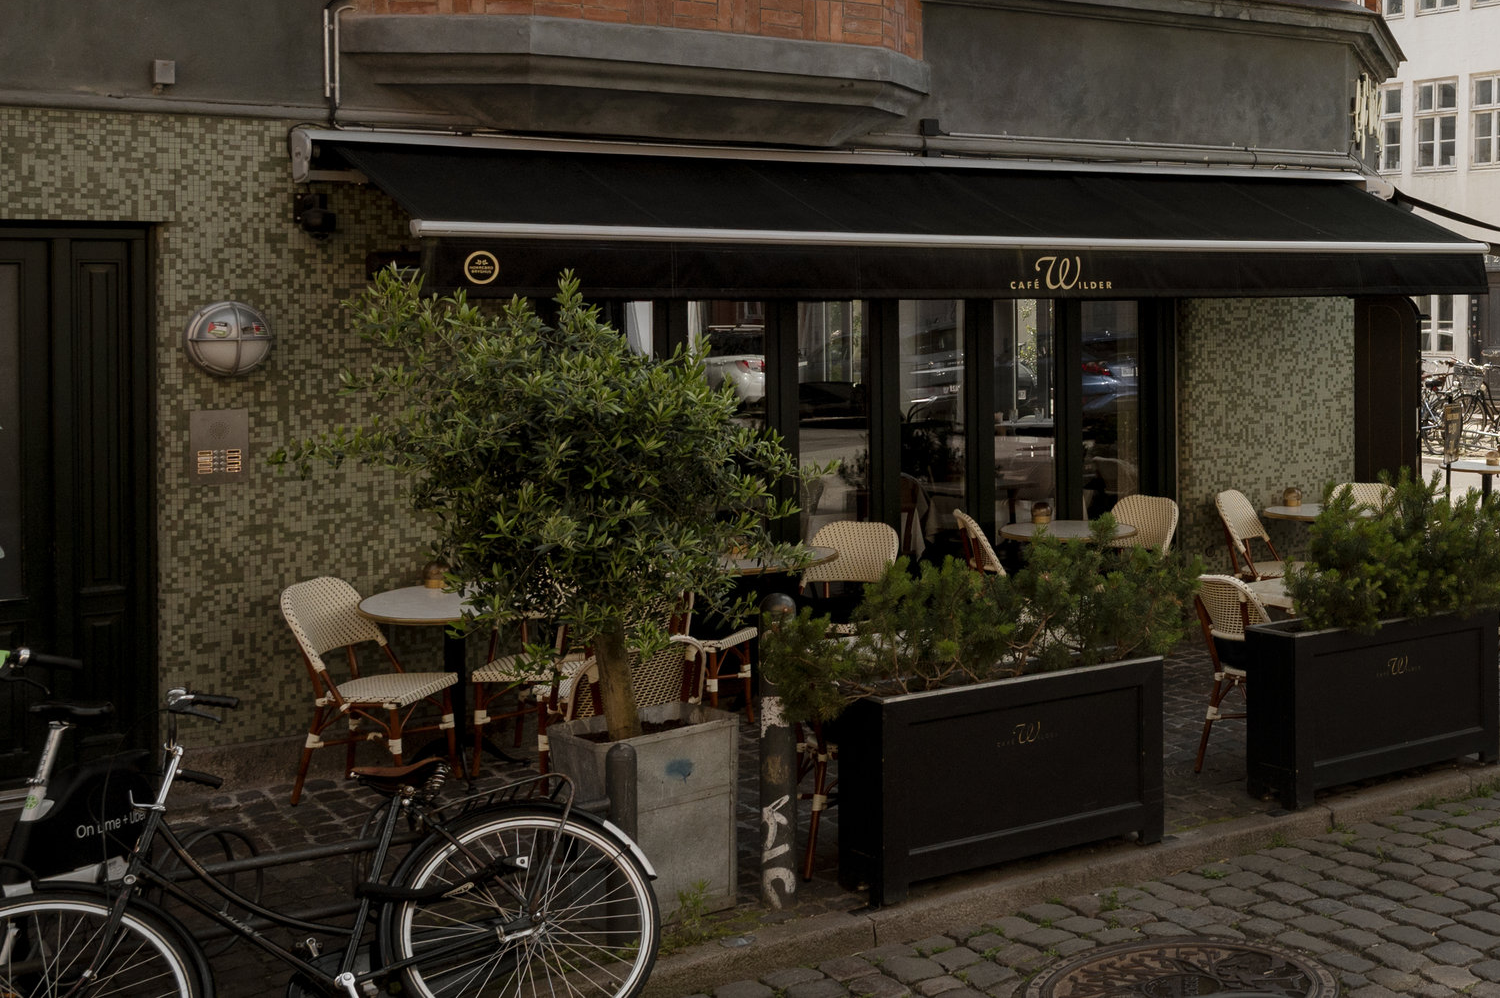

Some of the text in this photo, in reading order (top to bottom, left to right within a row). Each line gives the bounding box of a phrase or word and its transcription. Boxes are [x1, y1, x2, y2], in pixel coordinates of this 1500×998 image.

[1010, 255, 1113, 290] CAFÉ WILDER
[75, 824, 95, 839] On
[97, 817, 121, 834] Lme
